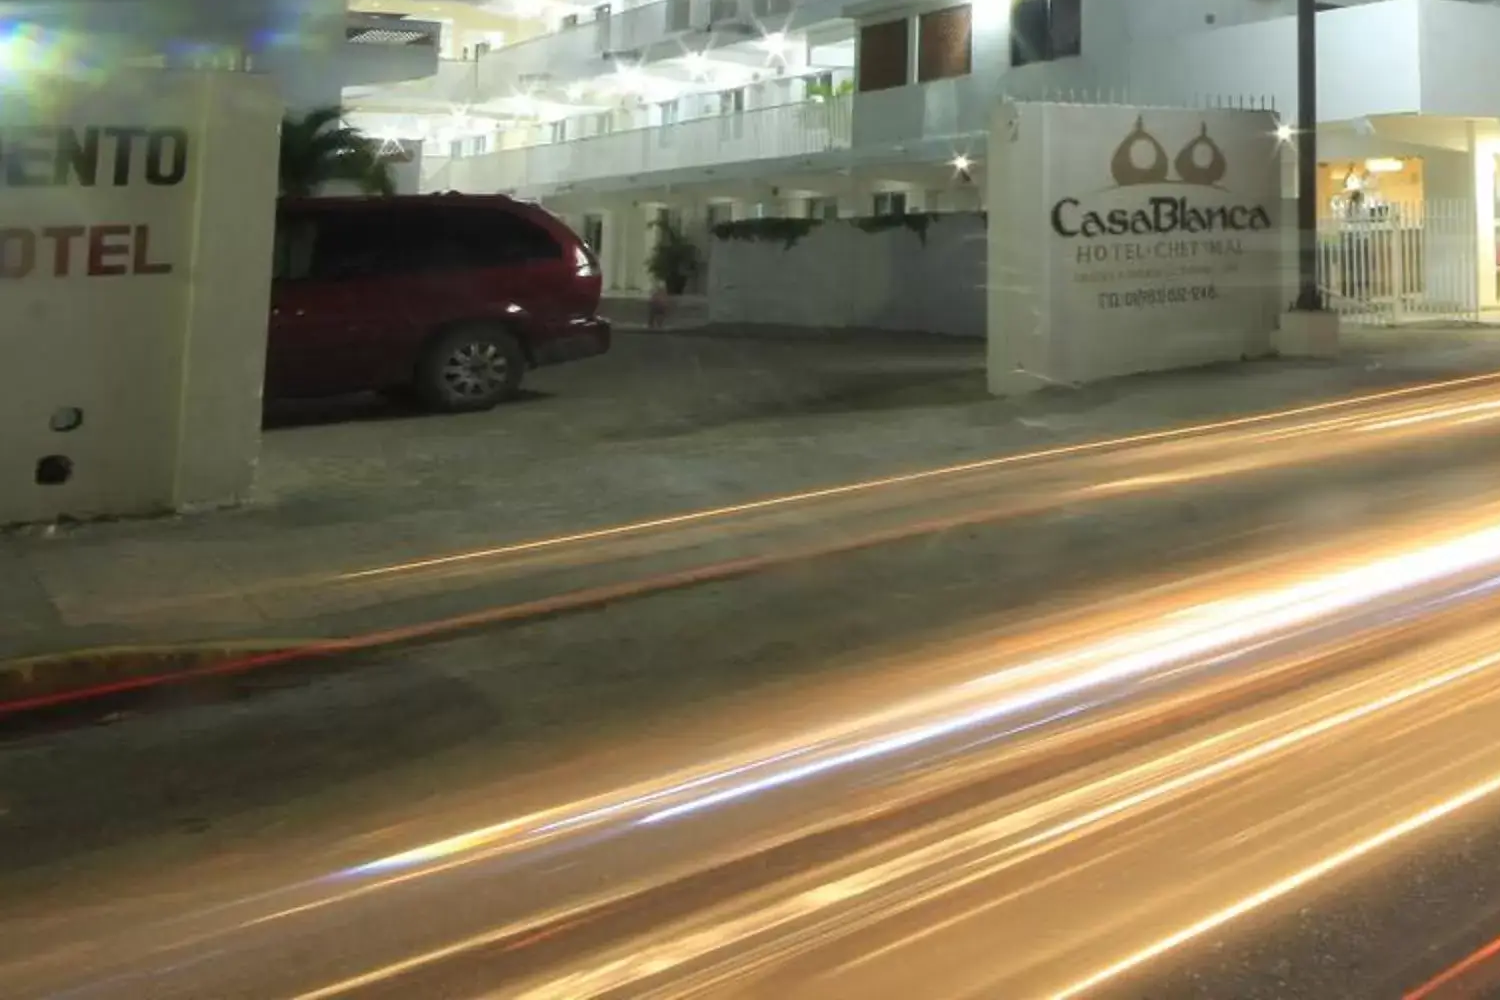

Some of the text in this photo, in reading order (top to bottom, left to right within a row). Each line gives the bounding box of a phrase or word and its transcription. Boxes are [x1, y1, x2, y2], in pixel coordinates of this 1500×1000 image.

[0, 126, 187, 187] ENTO
[1051, 197, 1271, 237] CasaBlanca
[1076, 243, 1144, 264] HOTEL
